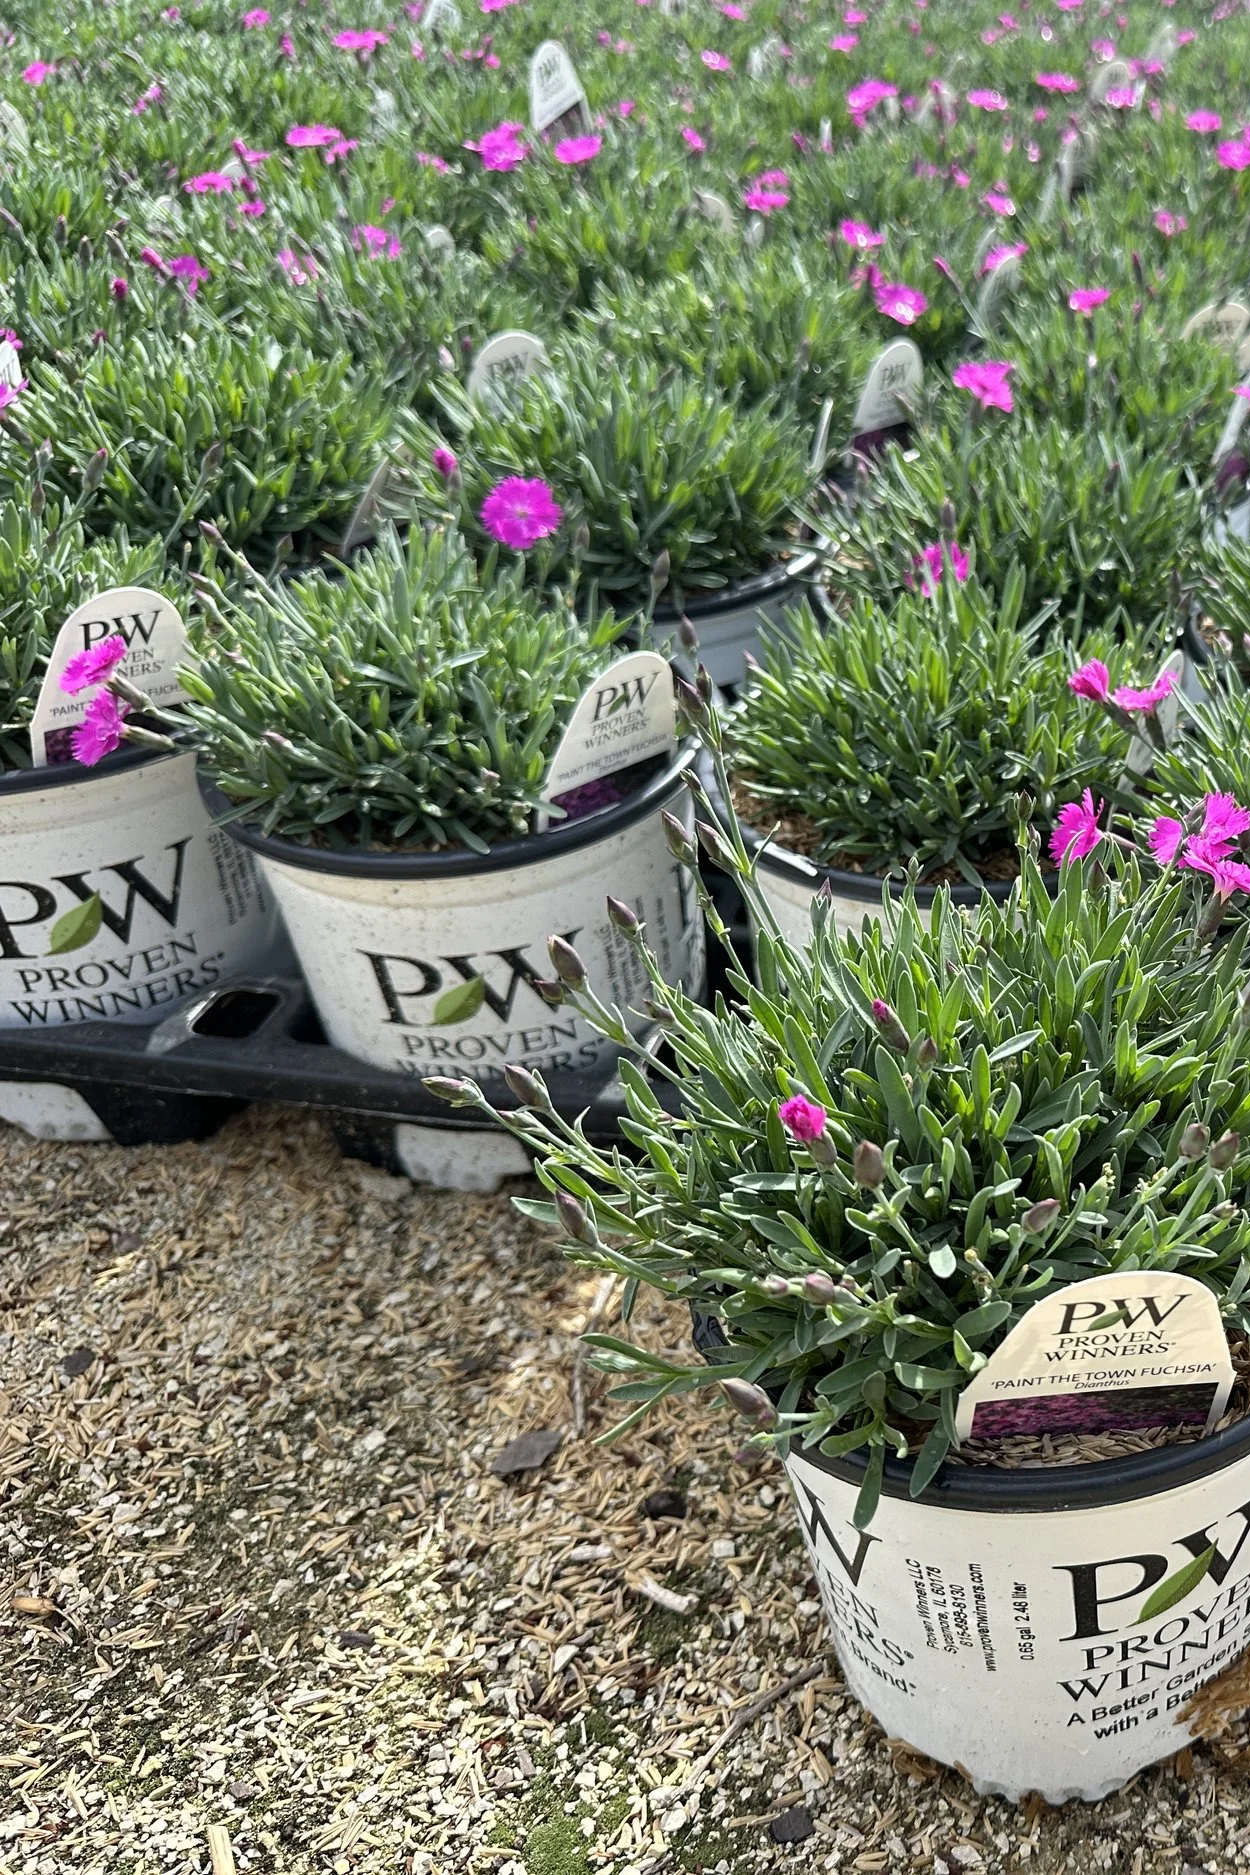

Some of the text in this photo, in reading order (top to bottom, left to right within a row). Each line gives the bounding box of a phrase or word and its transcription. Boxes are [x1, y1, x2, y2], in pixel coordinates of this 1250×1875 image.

[79, 610, 163, 651] PW
[114, 660, 165, 679] NERS
[590, 671, 662, 723] PW
[592, 708, 646, 736] PROVEN
[14, 932, 199, 994] PROVEN
[355, 926, 584, 1027] PW
[400, 1018, 579, 1061] PROVEN
[1051, 1293, 1193, 1336] PW
[1058, 1329, 1166, 1349] PROVEN
[1048, 1372, 1081, 1384] THE
[1086, 1368, 1137, 1382] TOWN
[1074, 1378, 1131, 1391] Dianthus
[905, 1558, 924, 1580] LLC
[914, 1580, 931, 1620] Winners
[1012, 1601, 1030, 1622] 2.48
[1016, 1627, 1036, 1641] gal
[1018, 1642, 1035, 1661] 0.65
[1066, 1711, 1086, 1727] A
[1091, 1687, 1160, 1722] Better
[1165, 1640, 1238, 1691] Garden
[1093, 1715, 1139, 1740] with
[1146, 1707, 1159, 1721] a
